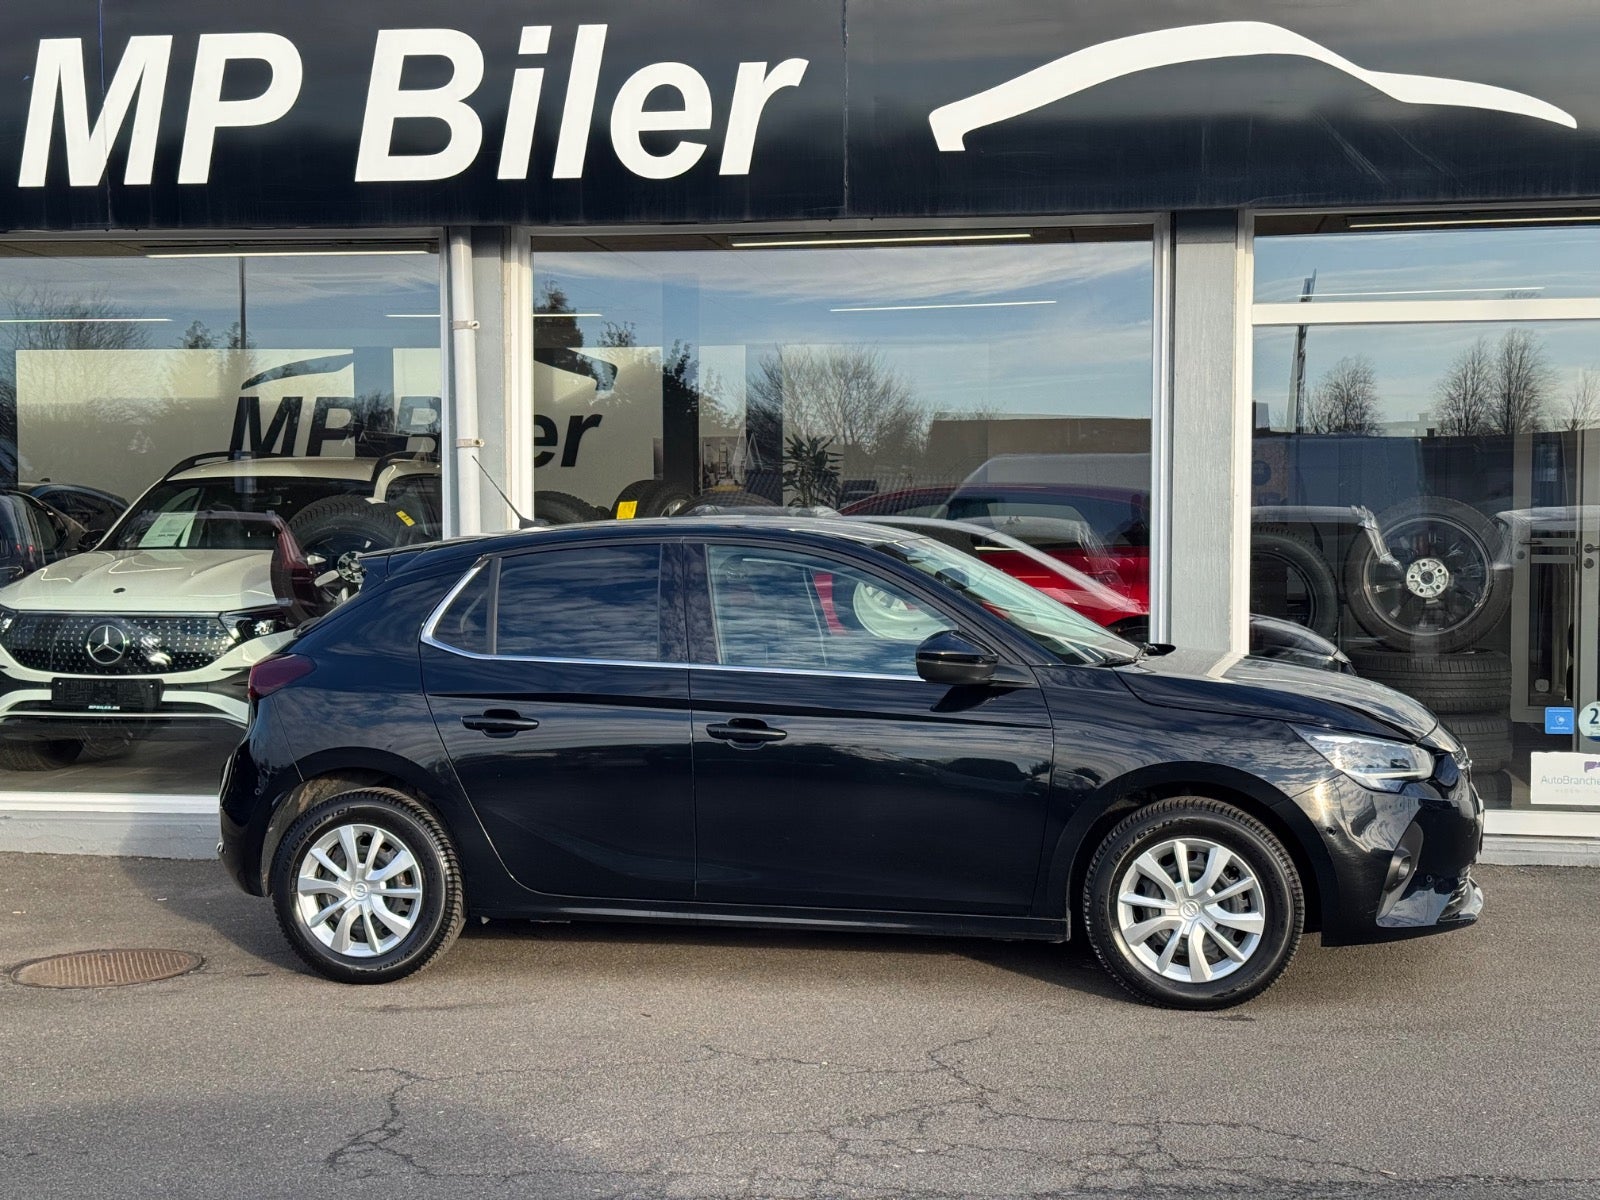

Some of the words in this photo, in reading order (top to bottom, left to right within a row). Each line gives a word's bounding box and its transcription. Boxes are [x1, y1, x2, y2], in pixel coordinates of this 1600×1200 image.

[18, 33, 303, 187] MP
[355, 24, 809, 182] Biler
[228, 396, 363, 460] MP
